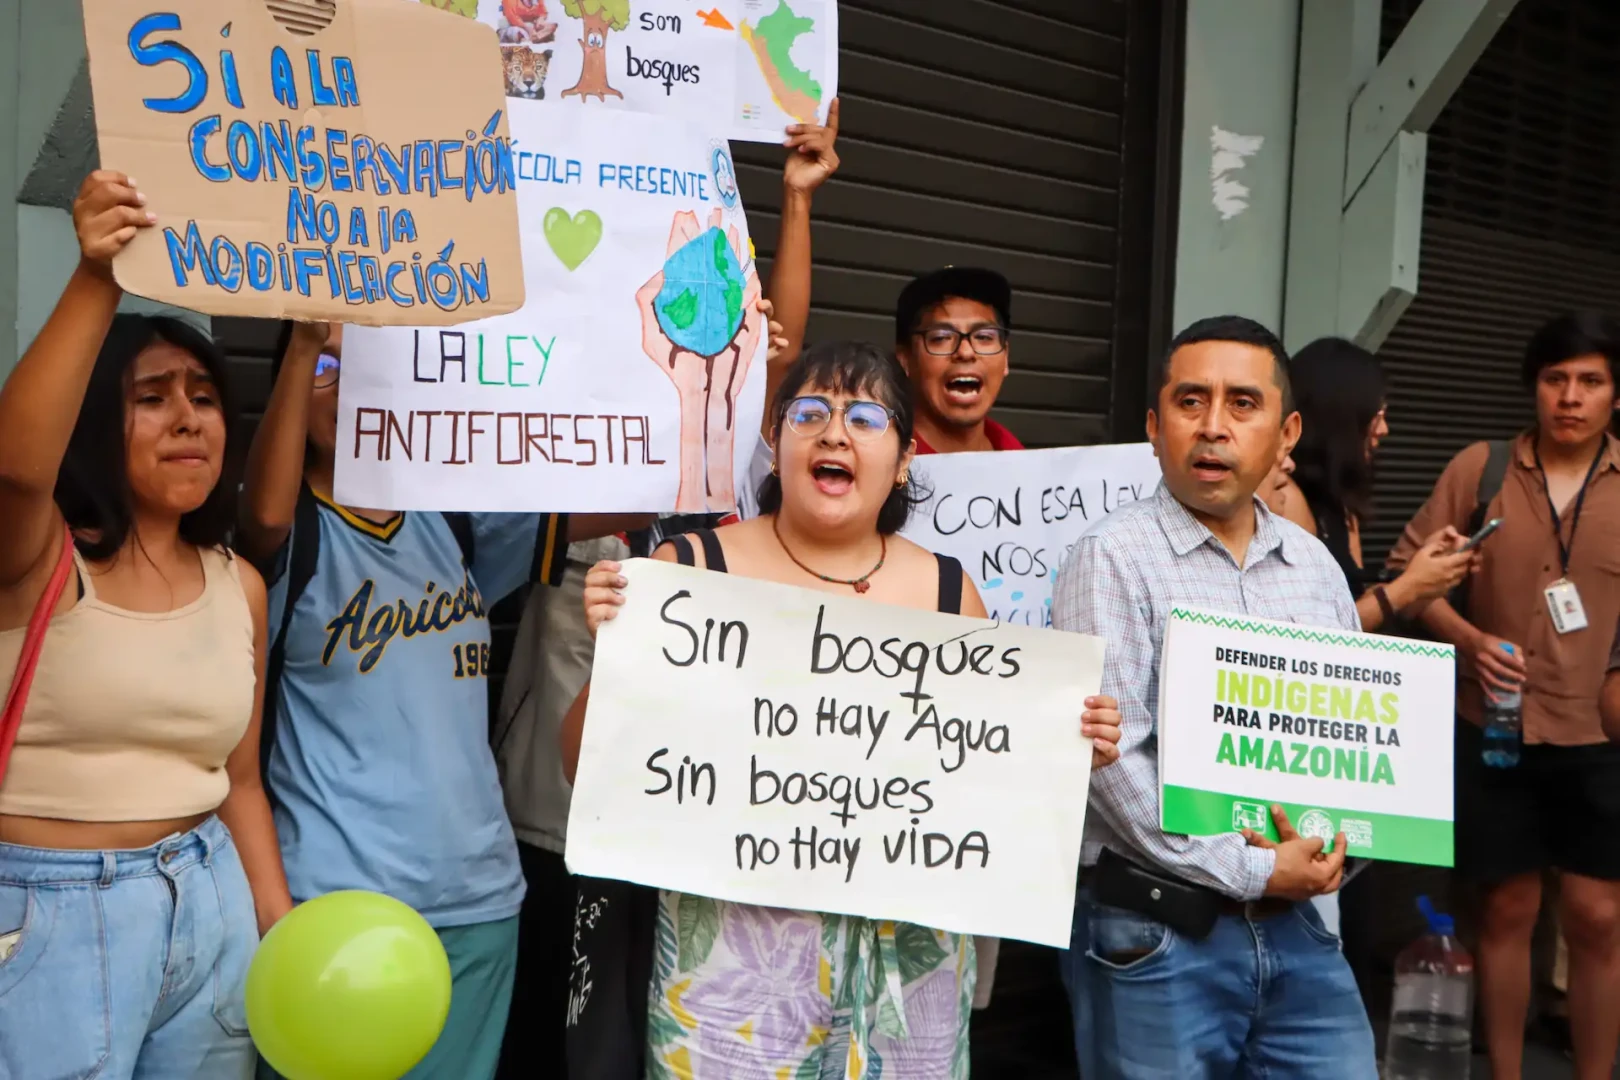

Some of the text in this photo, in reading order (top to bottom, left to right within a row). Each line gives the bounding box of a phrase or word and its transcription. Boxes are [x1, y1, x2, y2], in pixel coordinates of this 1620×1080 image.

[640, 12, 682, 35] son
[270, 45, 298, 109] A
[305, 48, 360, 107] LA
[626, 46, 700, 96] bosques
[598, 163, 710, 200] PRESENTE
[286, 186, 340, 244] NO
[348, 206, 370, 247] A
[413, 329, 557, 387] LA LEY
[354, 406, 667, 466] ANTIFORESTAL
[933, 486, 1022, 535] CON
[1041, 486, 1089, 524] ESA
[982, 541, 1048, 582] NOS
[660, 589, 1022, 715] Sin bosques
[1216, 646, 1402, 686] DEFENDER LOS DERECHOS
[1216, 669, 1400, 725] INDÍGENAS
[753, 696, 1011, 774] no Hay Agua
[1213, 704, 1401, 747] PARA PROTEGER LA
[1216, 732, 1396, 786] AMAZONÍA
[645, 747, 934, 828] Sin bosques
[735, 832, 780, 870] no
[789, 825, 861, 883] Hay
